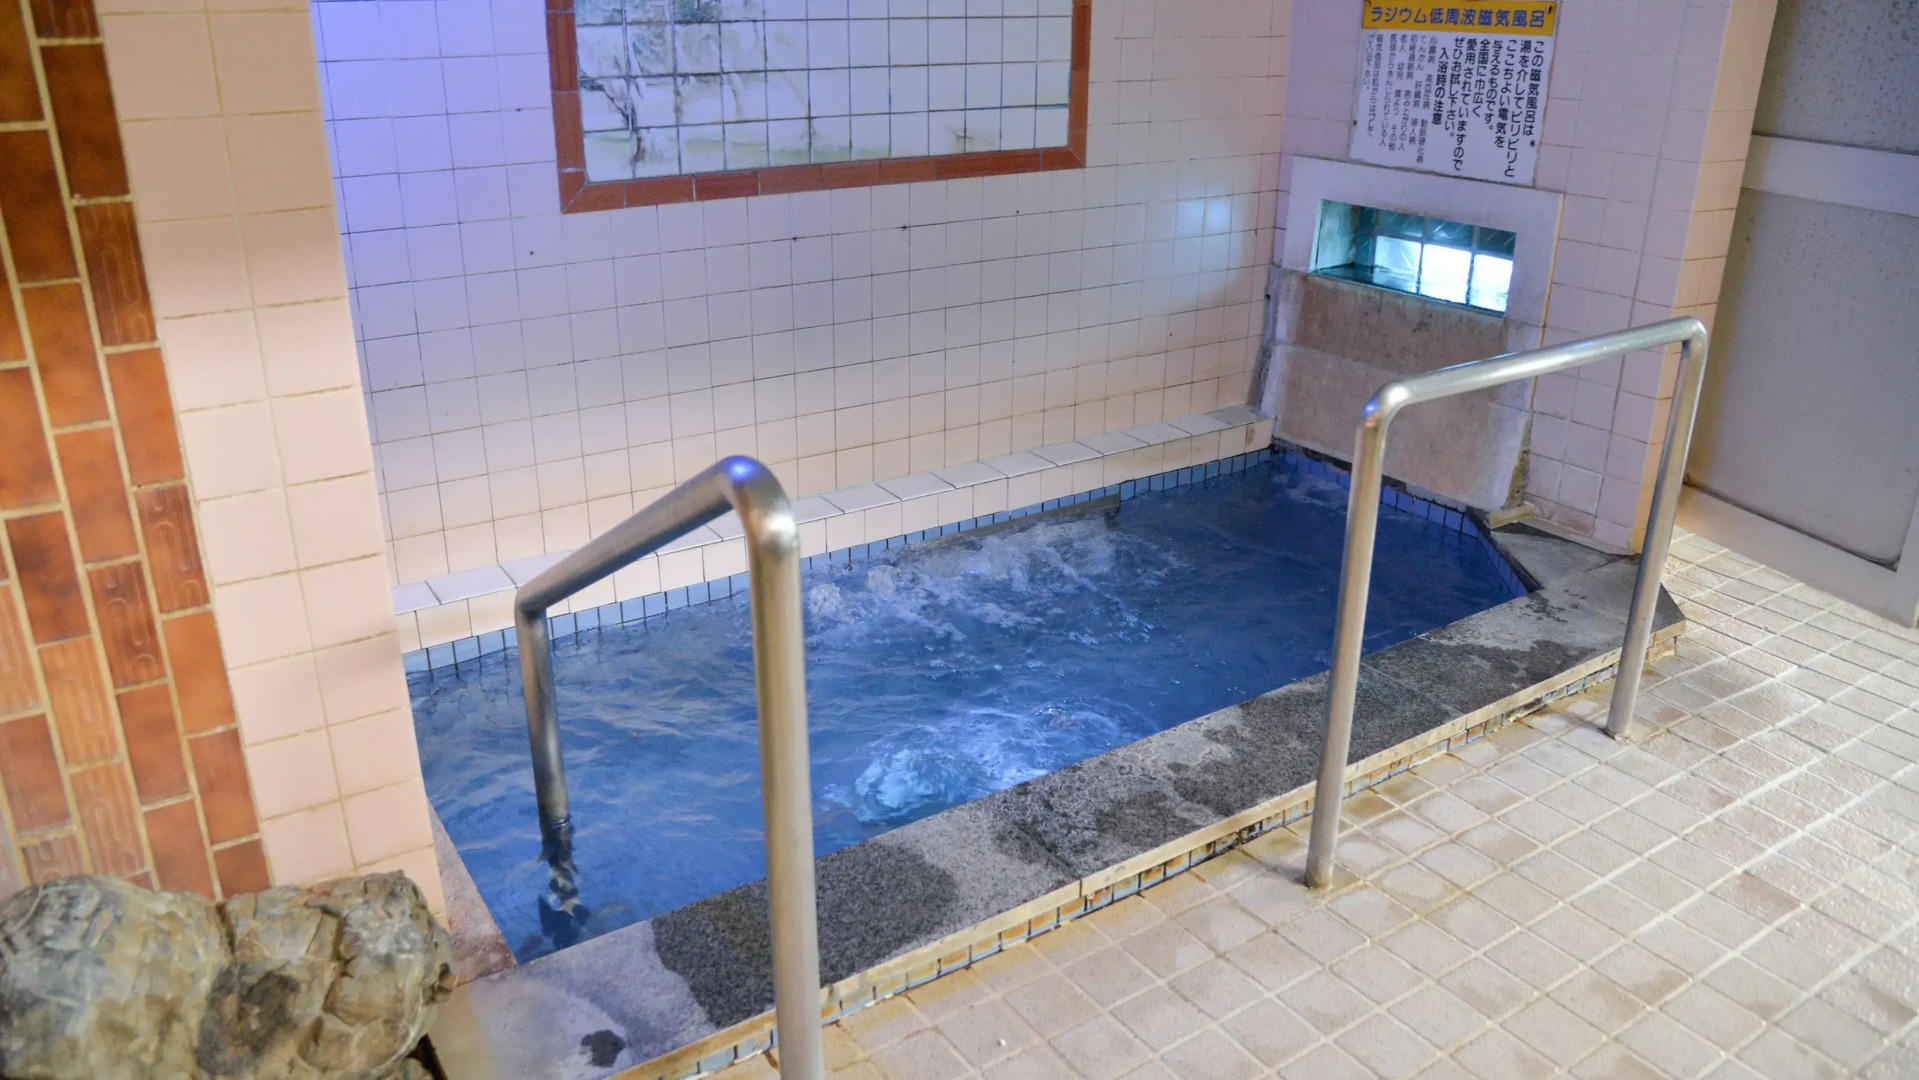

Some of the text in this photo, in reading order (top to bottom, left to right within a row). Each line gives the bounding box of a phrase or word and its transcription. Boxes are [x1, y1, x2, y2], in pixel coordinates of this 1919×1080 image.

[1371, 6, 1545, 28] ラジウム低周波磁気風呂
[1431, 47, 1449, 125] 入浴時の注意
[1445, 37, 1465, 137] ぜひお試し下さい。
[1453, 38, 1477, 171] 愛用されていますので
[1472, 38, 1491, 118] 全国に巾広く
[1484, 40, 1503, 130] 与えるものです。
[1494, 40, 1517, 148] ここちよい電気を
[1522, 41, 1544, 136] この磁気風呂は
